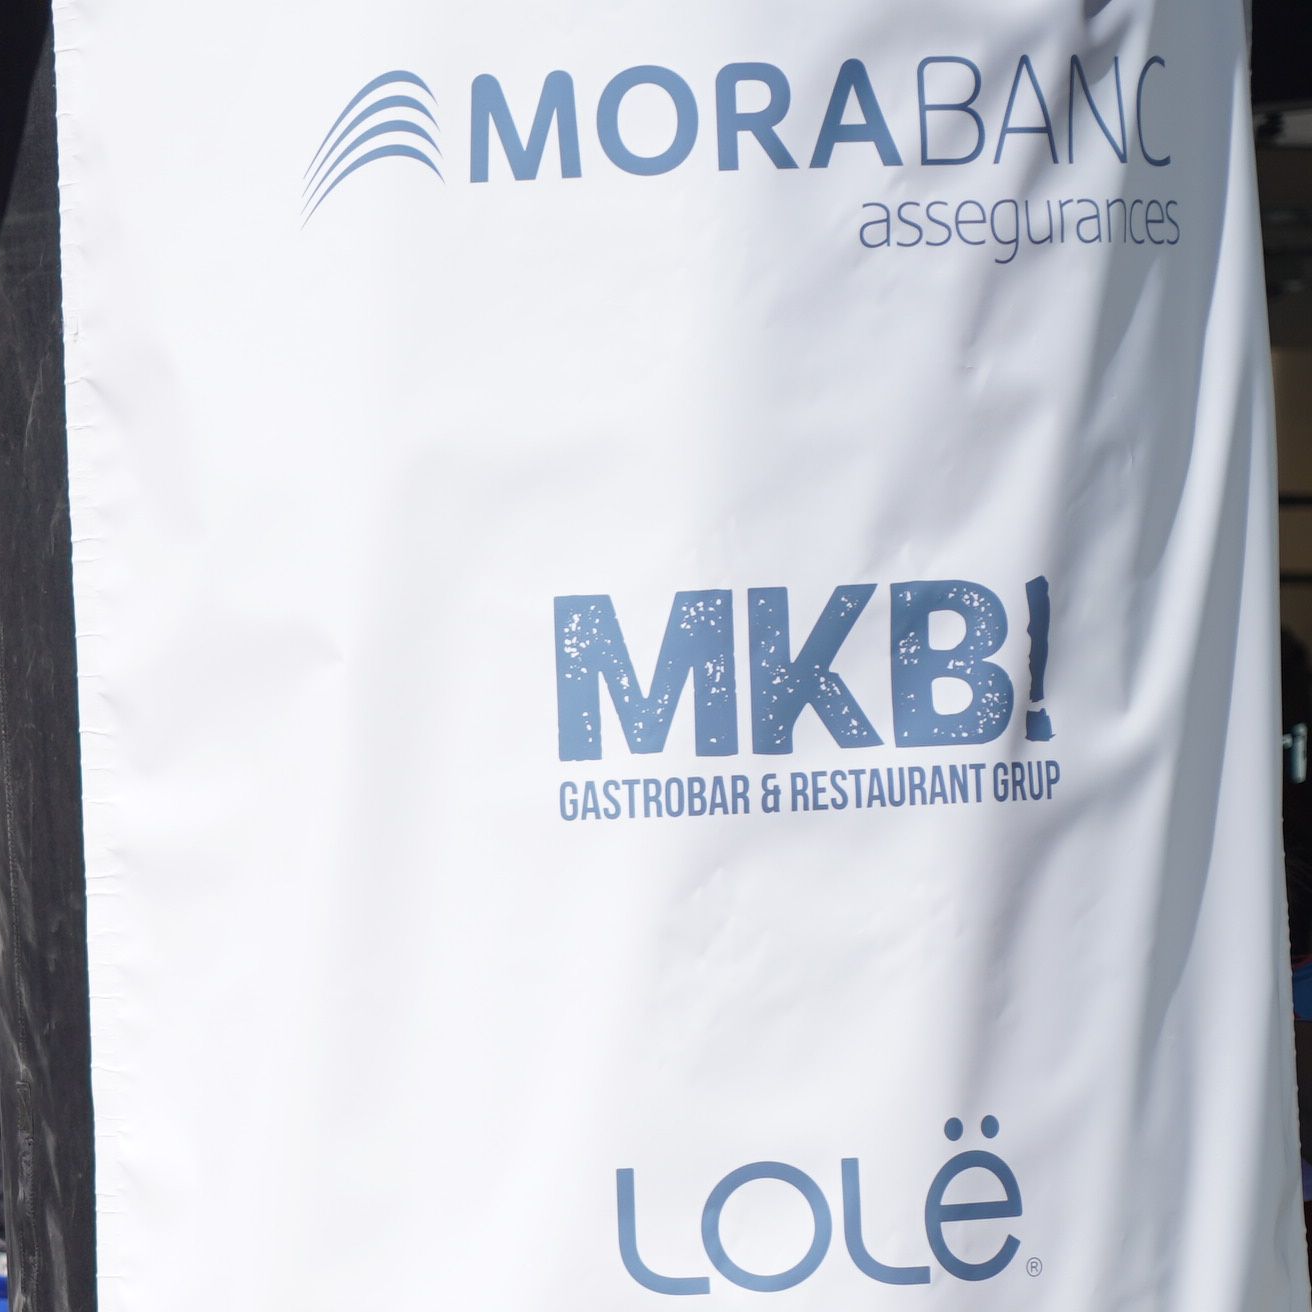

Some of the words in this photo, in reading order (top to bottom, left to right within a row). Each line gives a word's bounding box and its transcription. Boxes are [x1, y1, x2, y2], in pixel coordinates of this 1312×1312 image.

[469, 54, 1171, 184] MORABANC
[859, 198, 1180, 264] assegurances
[553, 574, 1056, 762] MKB!
[558, 773, 751, 821] GASTROBAR
[760, 771, 781, 814] &
[789, 761, 987, 813] RESTAURANT
[992, 759, 1061, 803] GRUP
